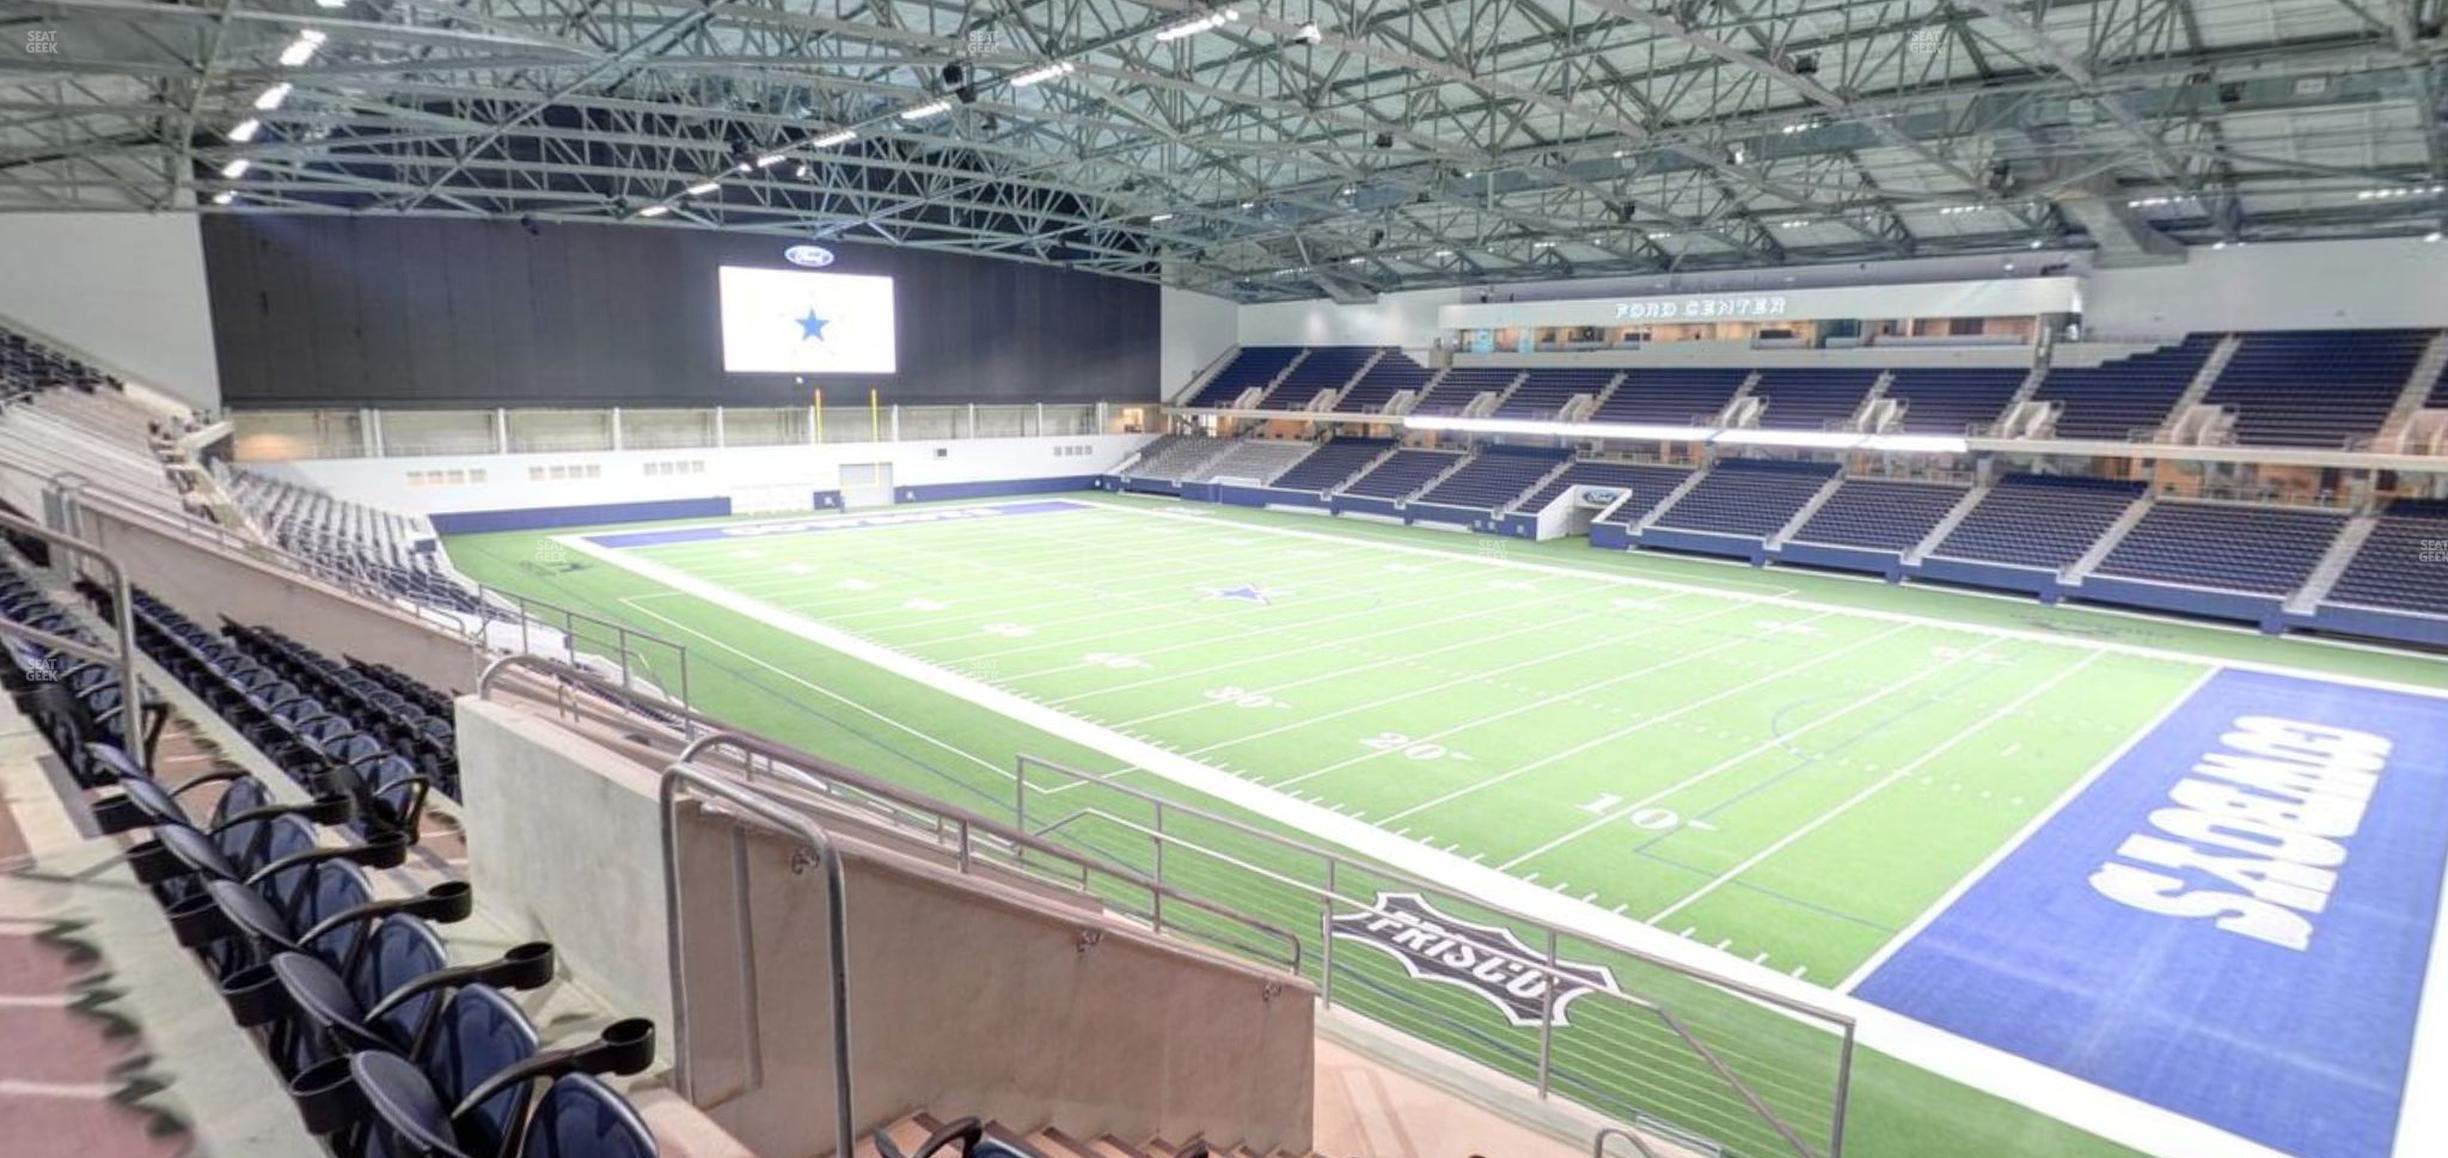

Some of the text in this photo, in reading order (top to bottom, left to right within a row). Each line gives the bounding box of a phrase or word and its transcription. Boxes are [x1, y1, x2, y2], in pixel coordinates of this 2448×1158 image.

[1616, 297, 1787, 319] FORD CENTER
[1359, 731, 1447, 760] 20
[1574, 792, 1679, 829] 10
[2088, 714, 2394, 952] COWBOYS
[1367, 910, 1562, 999] FRISCO
